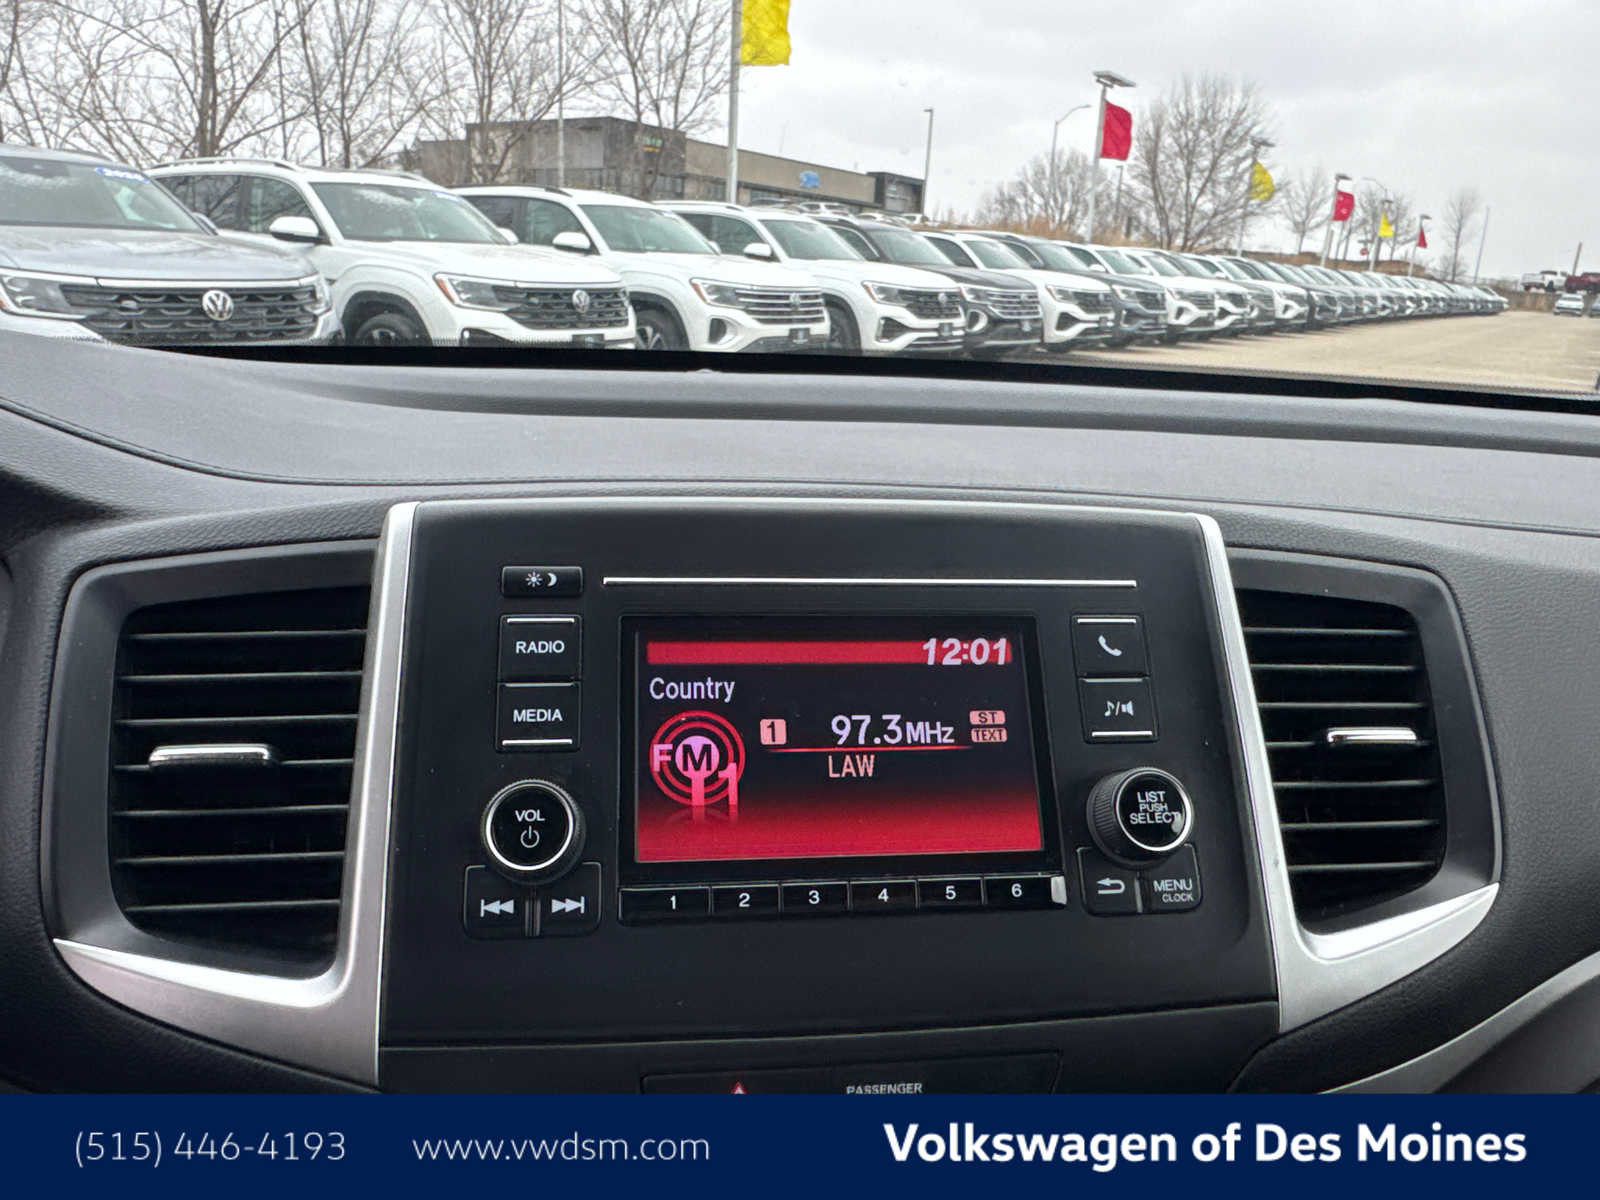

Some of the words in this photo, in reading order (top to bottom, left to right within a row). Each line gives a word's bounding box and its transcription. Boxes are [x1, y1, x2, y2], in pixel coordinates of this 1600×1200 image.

[515, 640, 565, 654] RADIO
[922, 638, 1009, 666] 12:01
[649, 677, 735, 703] Country
[513, 708, 563, 722] MEDIA
[978, 711, 998, 724] ST
[766, 721, 776, 743] 1
[973, 729, 1006, 742] TEXT
[827, 754, 875, 778] LAW
[1137, 791, 1166, 803] LIST
[1139, 802, 1168, 812] PUSH
[515, 809, 545, 822] VOL
[1129, 811, 1181, 825] SELECT
[944, 884, 956, 900] 5
[1010, 882, 1023, 898] 6
[1153, 878, 1193, 892] MENU
[738, 892, 751, 908] 2
[808, 889, 820, 905] 3
[877, 887, 889, 903] 4
[1161, 892, 1194, 903] CLOCK
[669, 895, 677, 910] 1
[846, 1082, 923, 1095] PASSENGER
